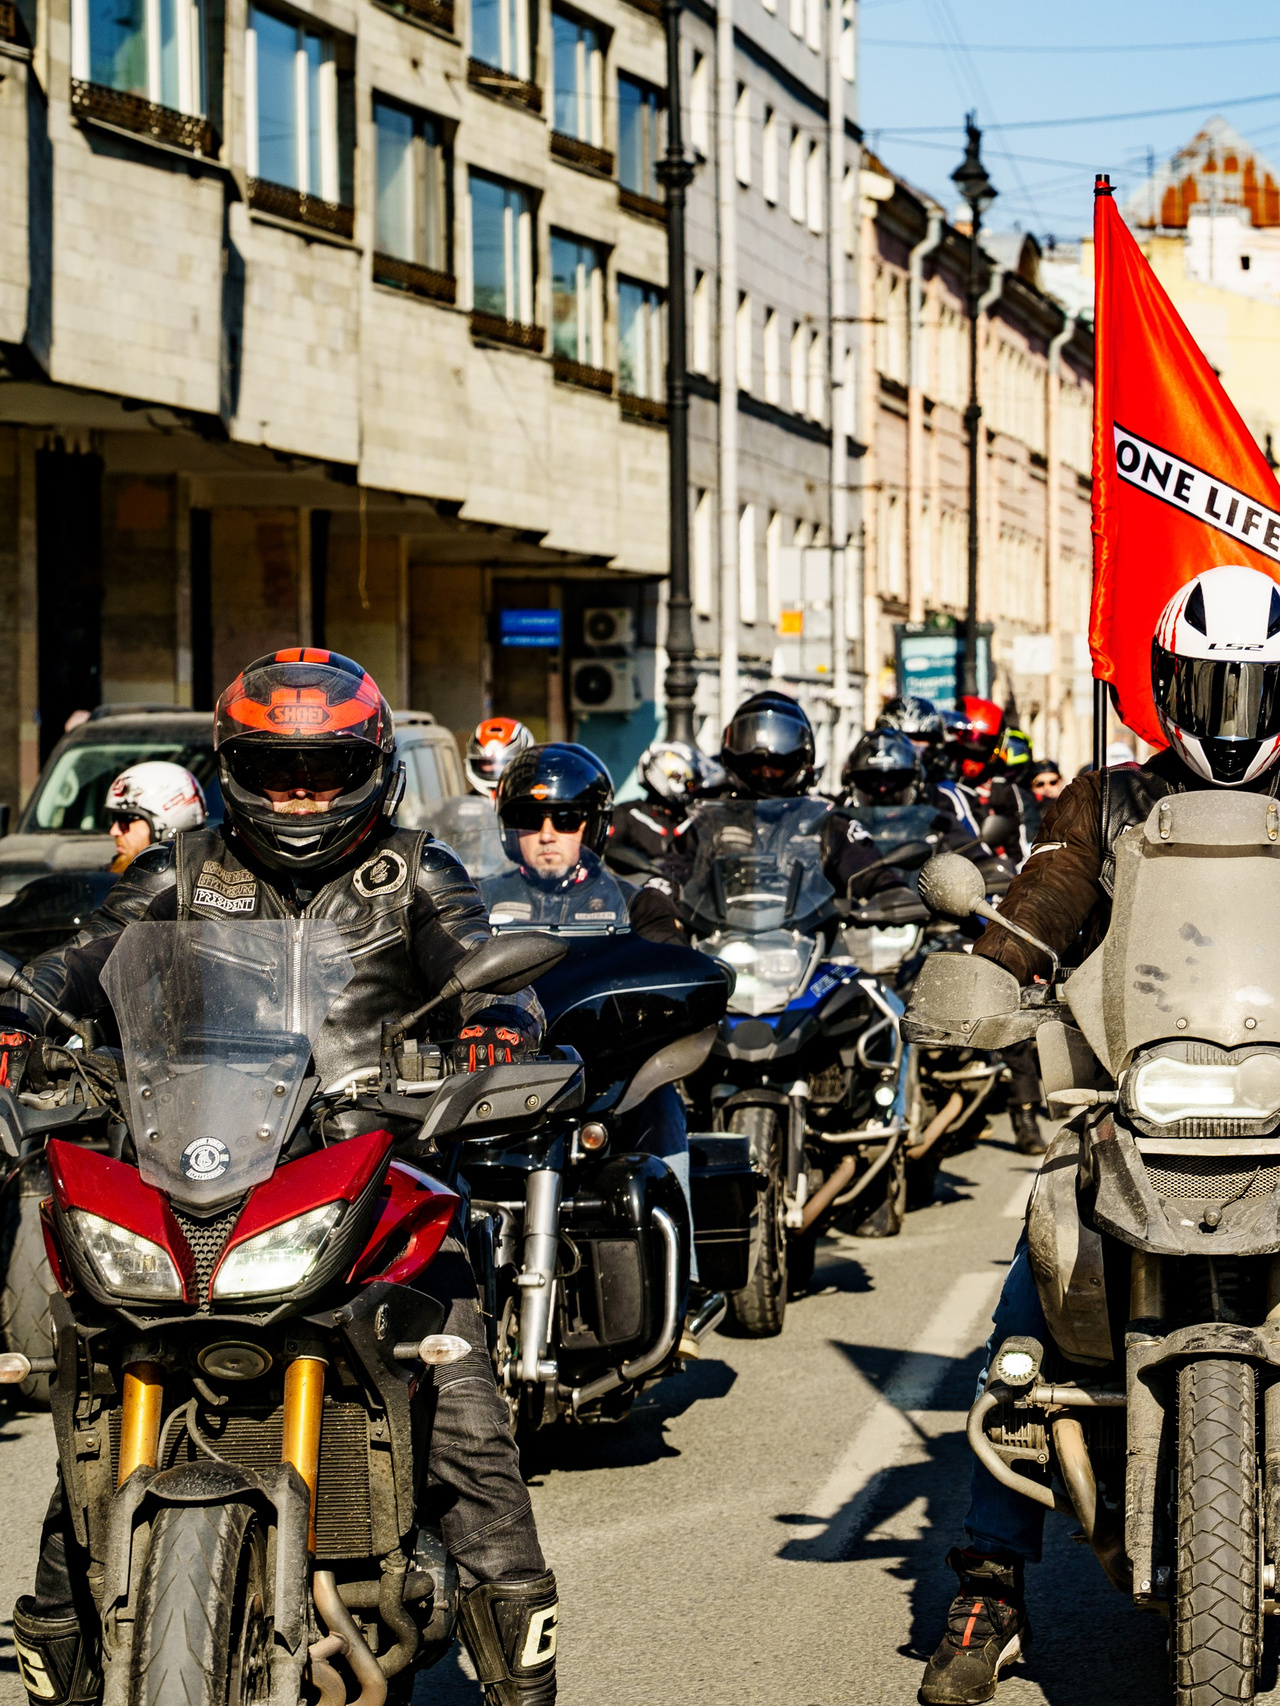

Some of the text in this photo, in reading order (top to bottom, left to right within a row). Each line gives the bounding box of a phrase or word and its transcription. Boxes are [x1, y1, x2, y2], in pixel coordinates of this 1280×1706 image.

[1116, 440, 1195, 504] ONE
[1208, 643, 1264, 652] LS2
[274, 707, 323, 723] SHOEI
[199, 891, 251, 910] PRESIDENT
